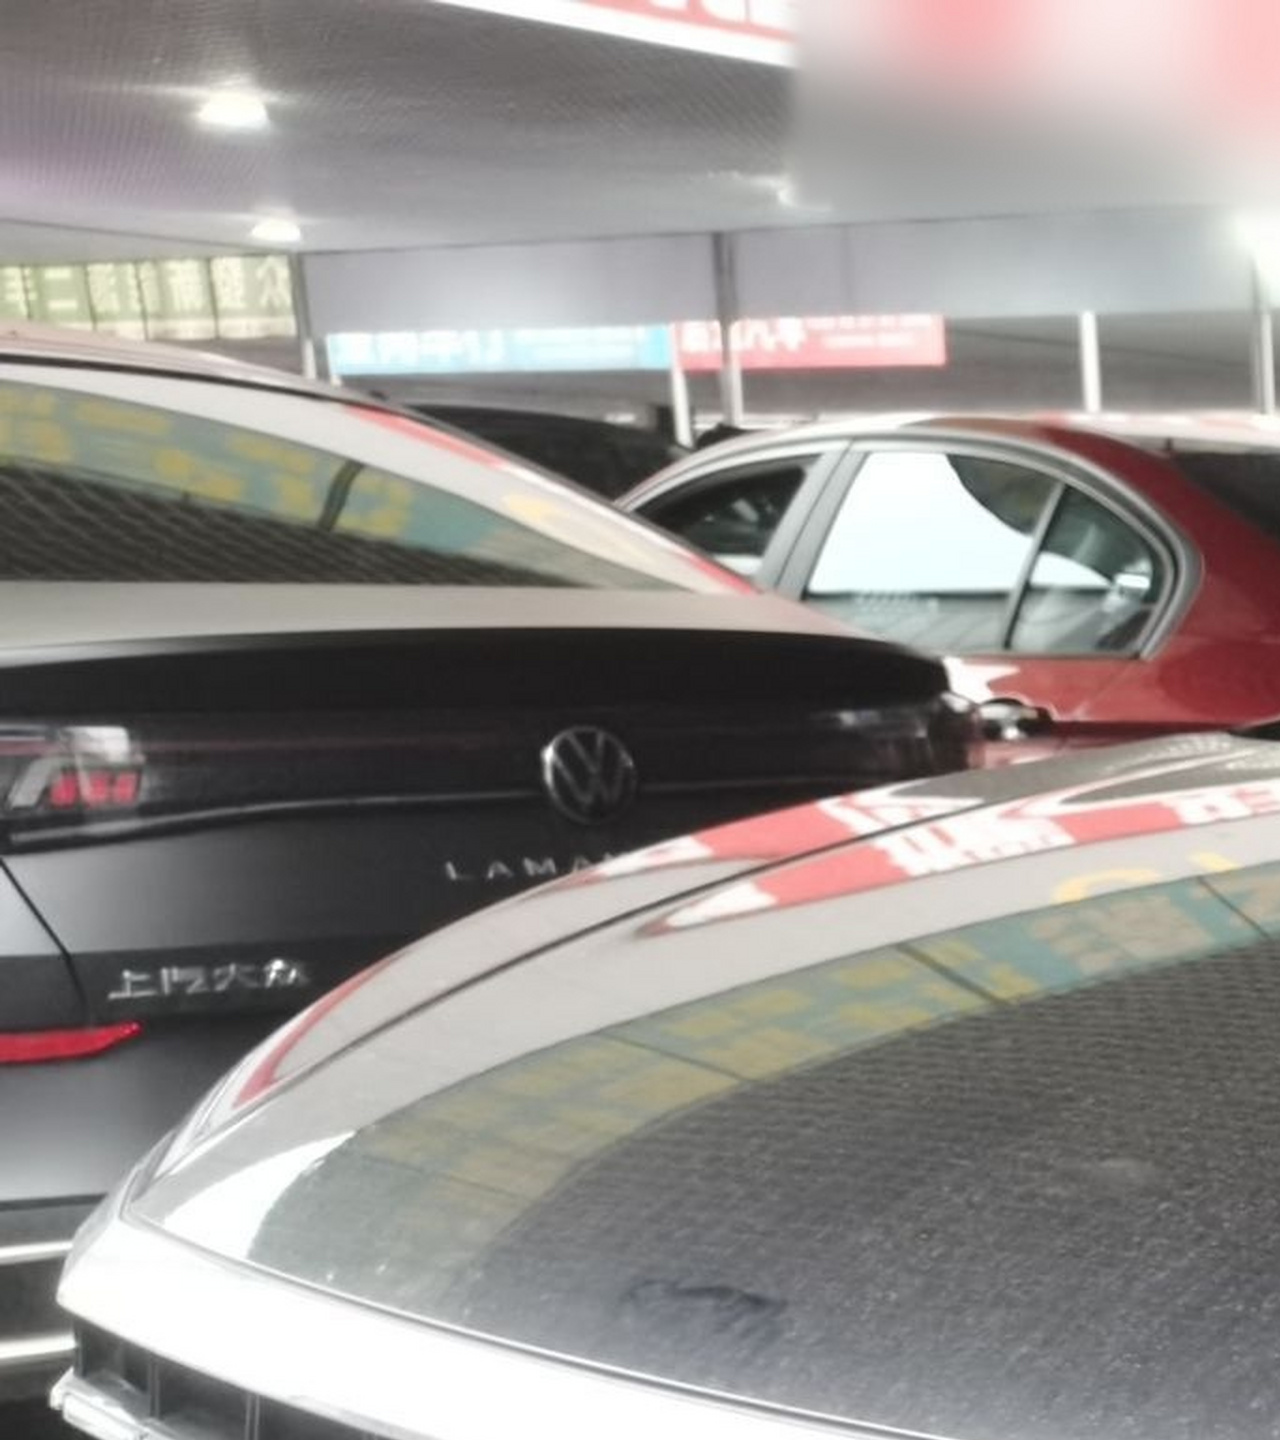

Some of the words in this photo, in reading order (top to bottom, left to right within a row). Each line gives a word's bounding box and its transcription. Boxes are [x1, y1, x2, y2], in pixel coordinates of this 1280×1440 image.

[444, 852, 616, 881] LAMA
[108, 958, 309, 1000] 上汽大众
